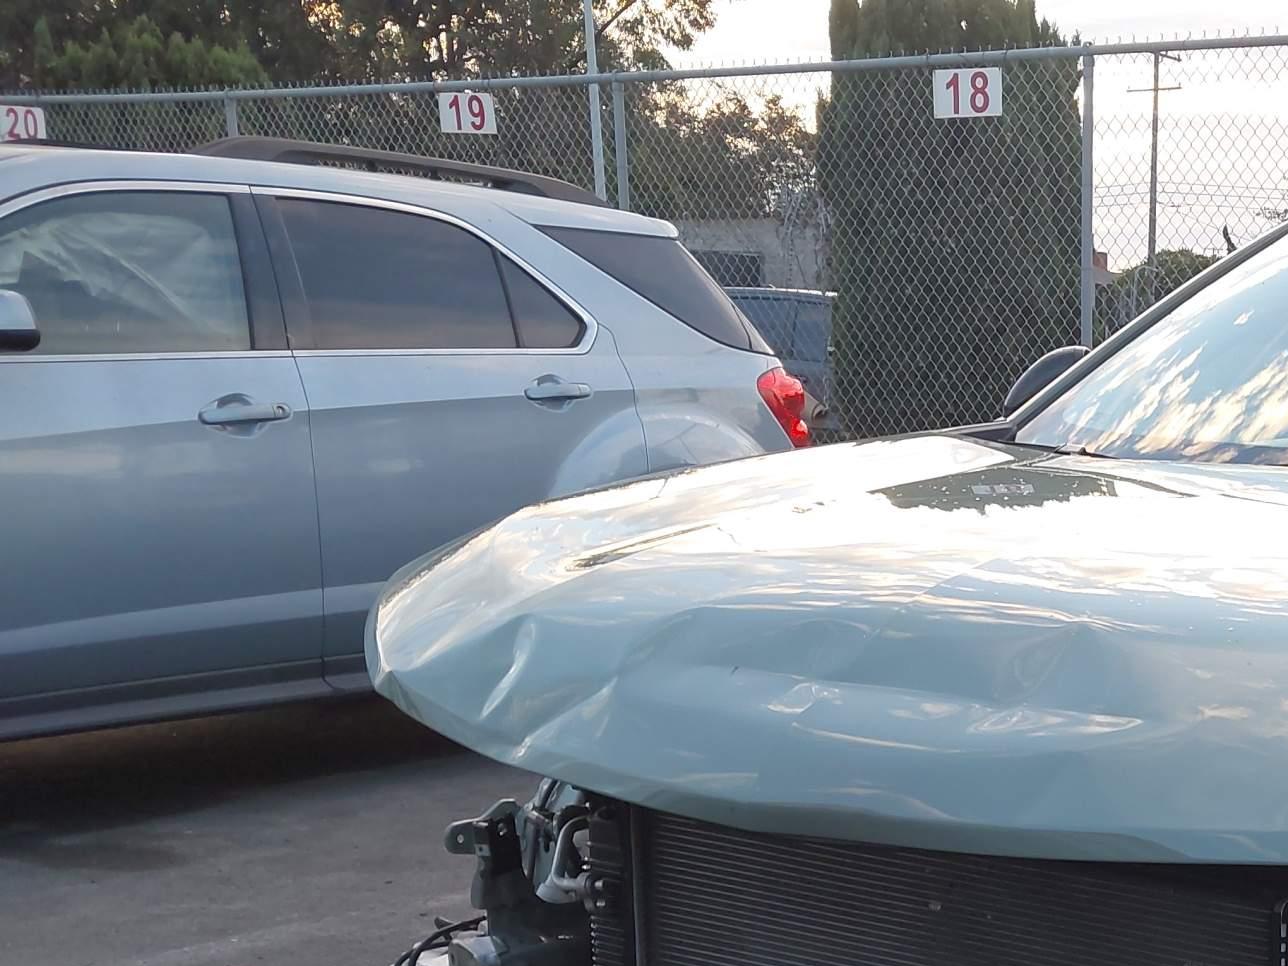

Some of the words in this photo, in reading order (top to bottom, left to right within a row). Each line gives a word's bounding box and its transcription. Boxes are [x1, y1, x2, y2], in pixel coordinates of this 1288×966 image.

[945, 70, 991, 115] 18
[6, 107, 38, 139] 20
[449, 95, 486, 130] 19
